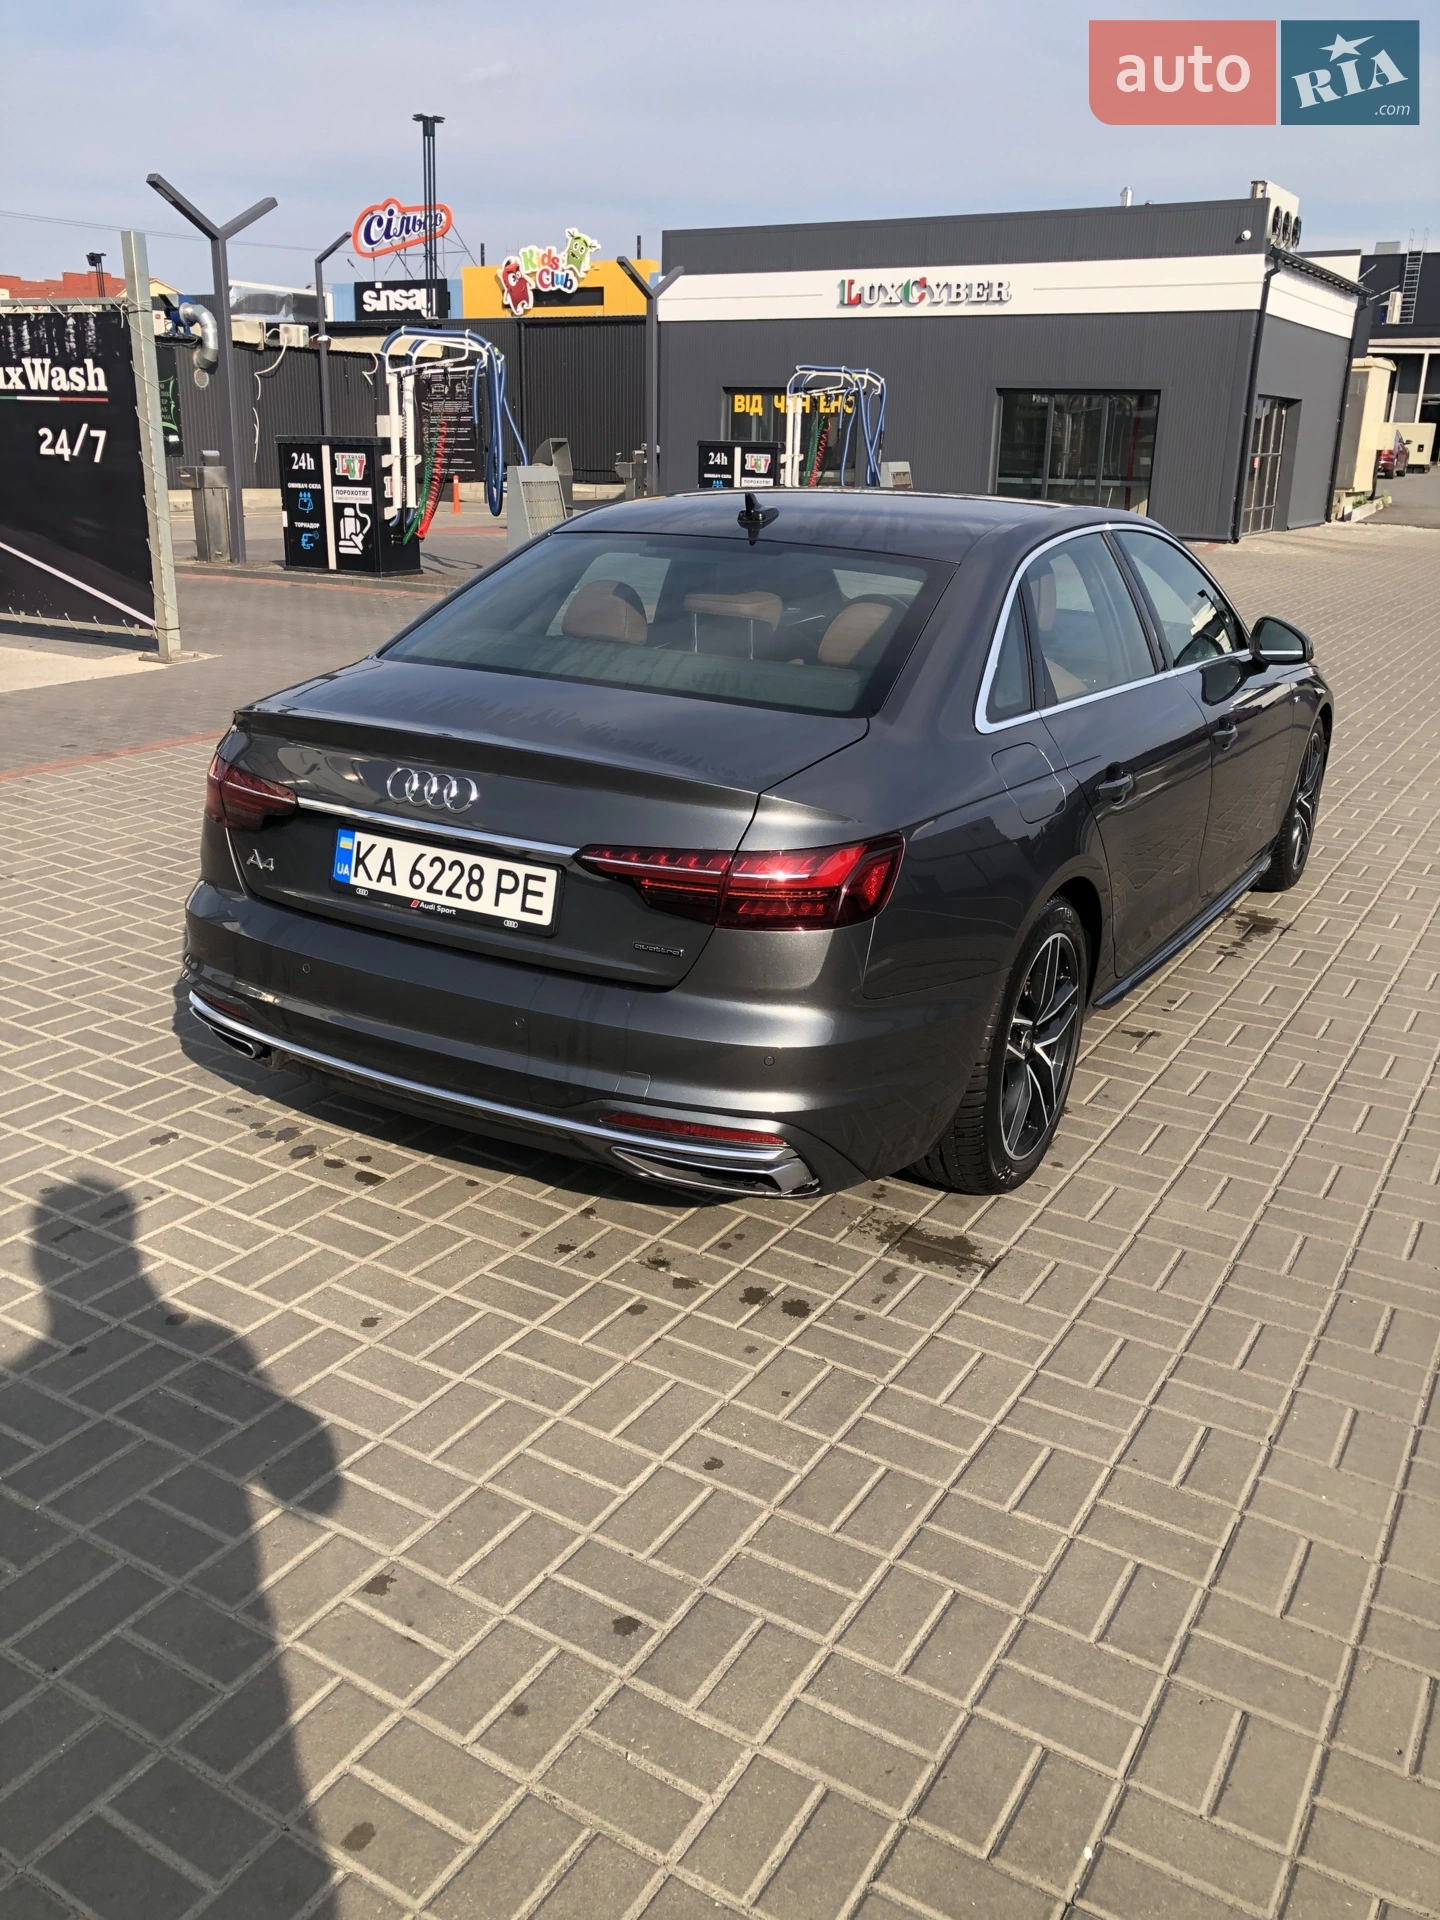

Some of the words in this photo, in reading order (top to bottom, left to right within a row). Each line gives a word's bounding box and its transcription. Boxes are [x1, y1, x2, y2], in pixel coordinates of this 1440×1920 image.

[521, 248, 560, 272] Kids
[538, 268, 574, 291] Club
[362, 282, 437, 319] sinsay
[37, 423, 107, 463] 24/7
[290, 452, 315, 471] 24h
[707, 451, 729, 466] 24h
[335, 489, 370, 497] ПОРОХОТЯГ
[246, 848, 275, 871] A4
[337, 862, 350, 876] UA
[353, 840, 397, 887] KA
[408, 853, 485, 902] 6228
[494, 867, 547, 916] PE
[419, 901, 436, 911] Audi
[436, 905, 457, 915] Sport
[634, 943, 680, 956] quattro
